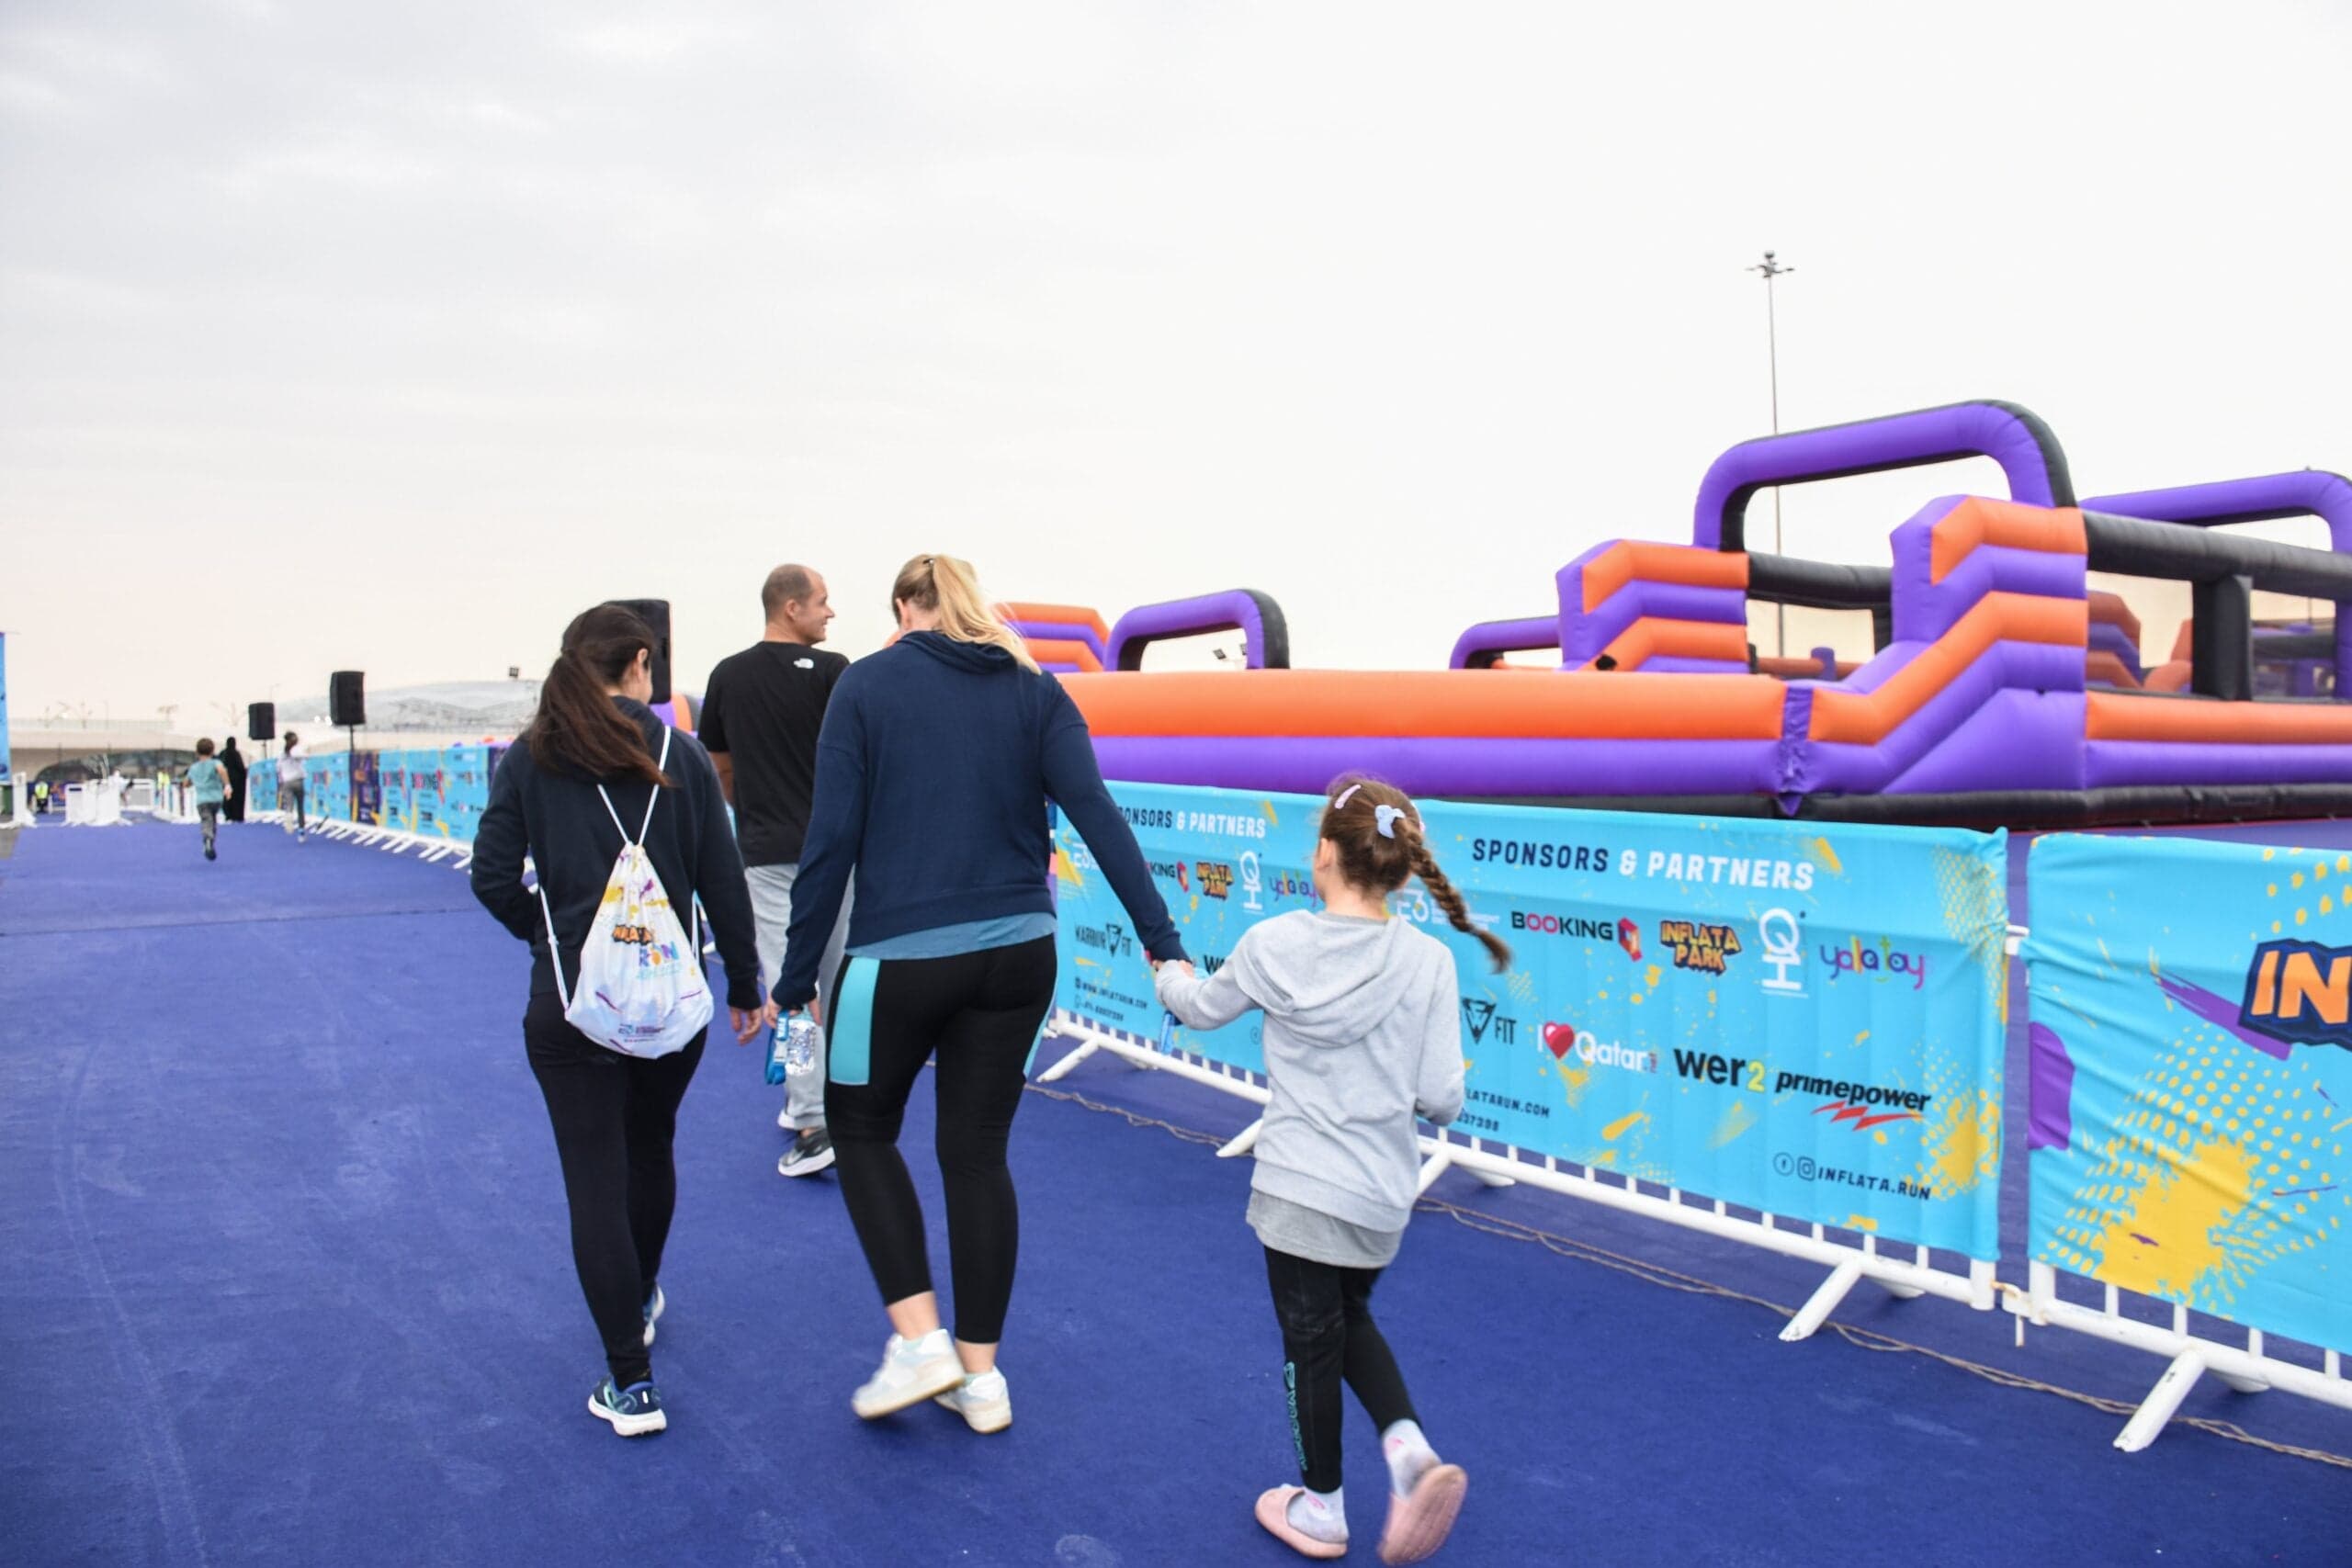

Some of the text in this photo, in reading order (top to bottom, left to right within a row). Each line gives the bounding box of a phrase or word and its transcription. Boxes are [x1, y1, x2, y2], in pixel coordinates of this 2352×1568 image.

[1117, 806, 1266, 840] ONSORS & PARTNERS
[1472, 837, 1815, 892] SPONSORS & PARTNERS
[1511, 910, 1614, 942] BOOKING
[1660, 920, 1743, 956] INFLATA
[1674, 943, 1727, 976] PARK
[2250, 950, 2352, 1025] IN
[1495, 1015, 1517, 1046] FIT
[1774, 1070, 1932, 1112] primepower
[1817, 1165, 1932, 1201] INFLATA.RUN
